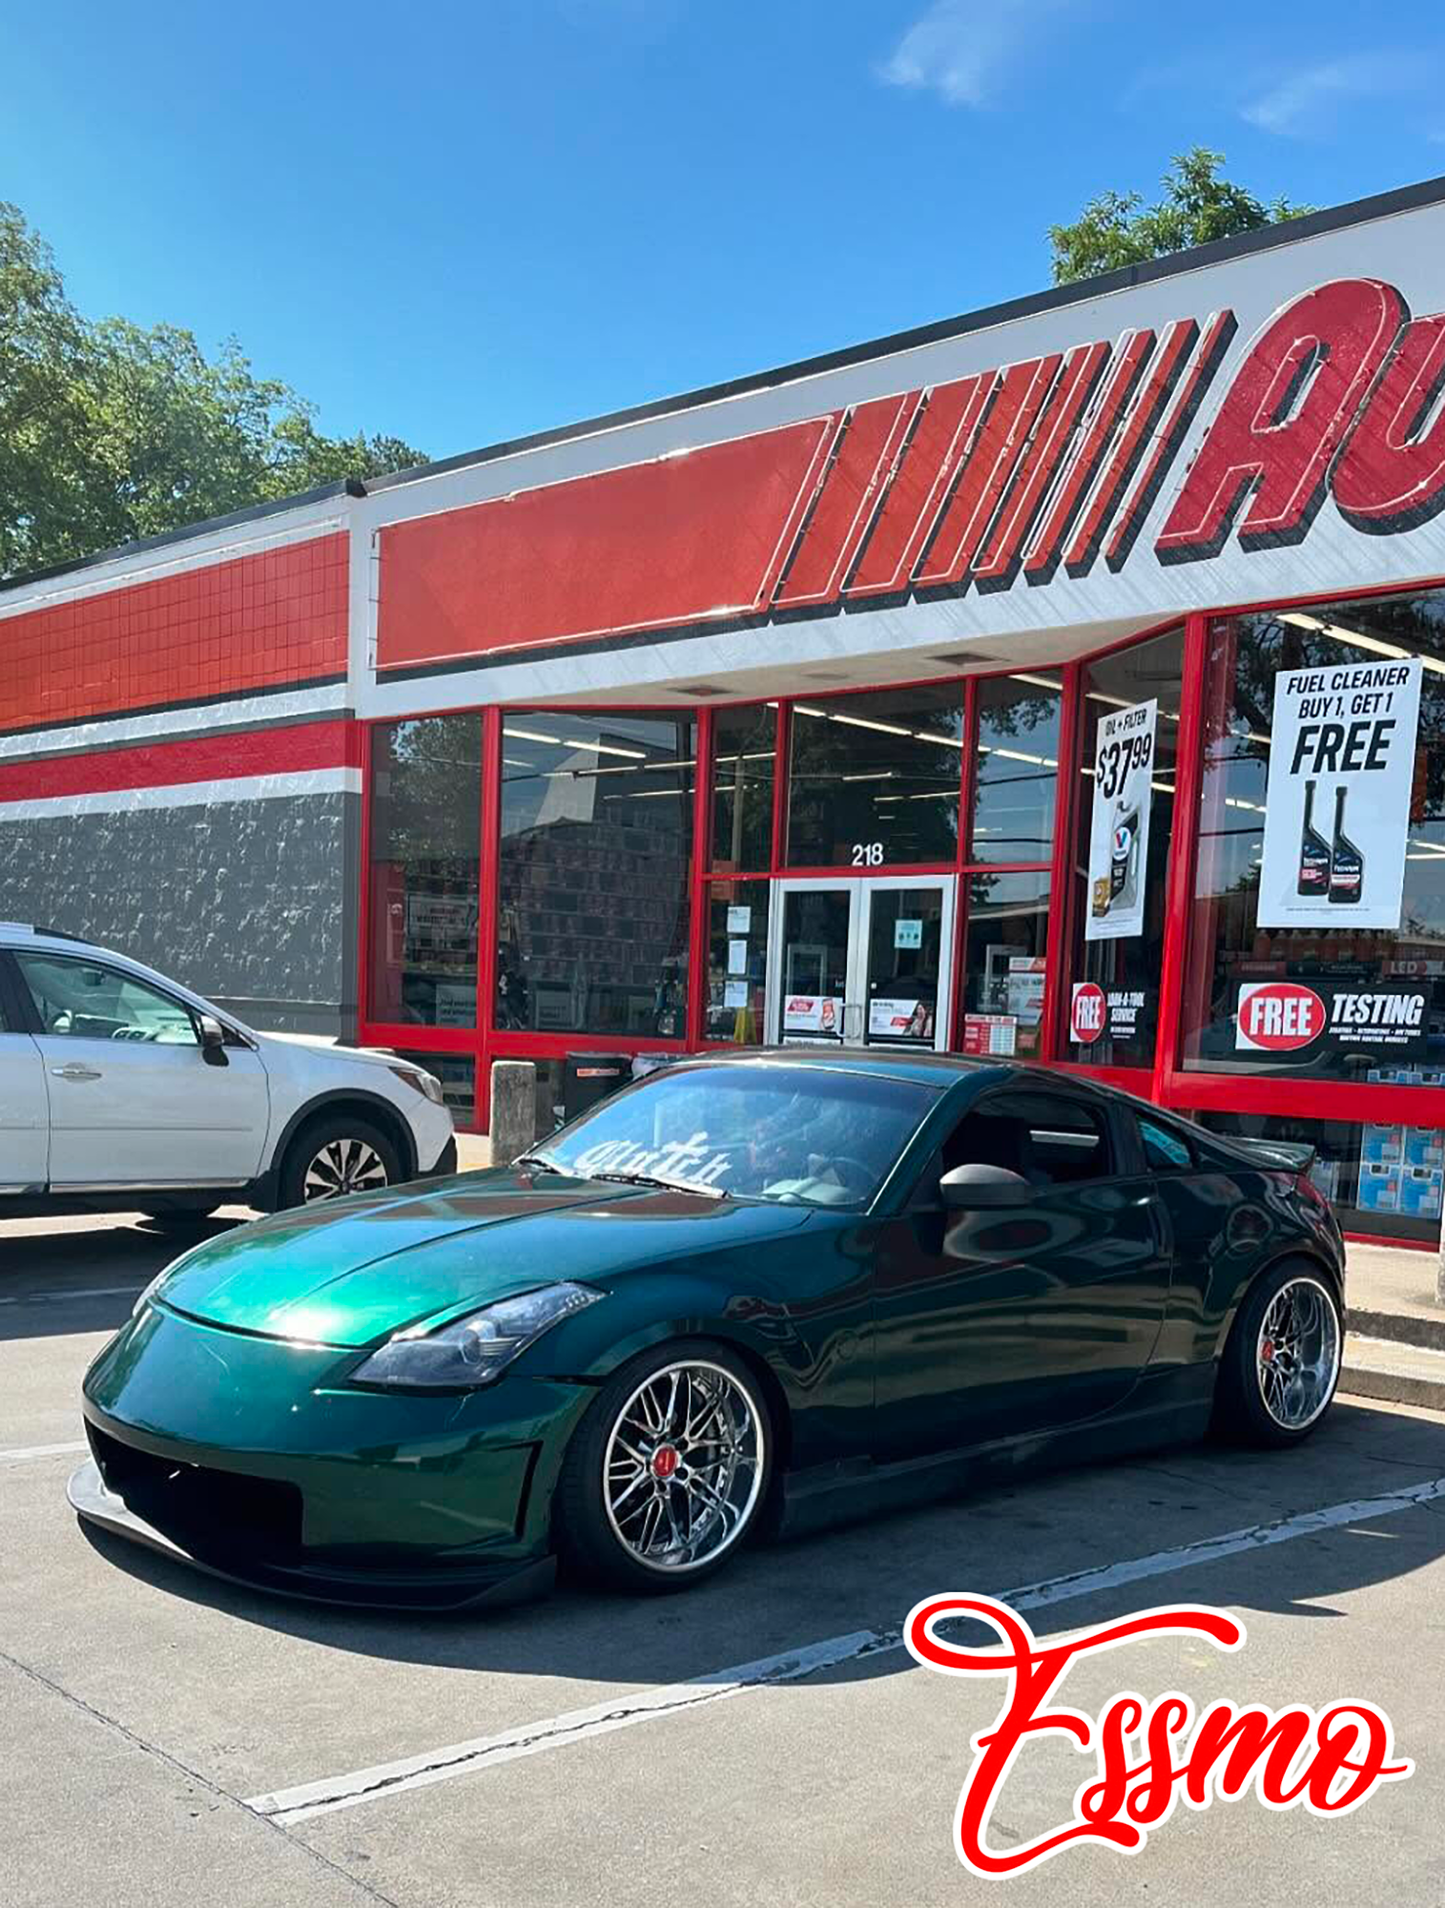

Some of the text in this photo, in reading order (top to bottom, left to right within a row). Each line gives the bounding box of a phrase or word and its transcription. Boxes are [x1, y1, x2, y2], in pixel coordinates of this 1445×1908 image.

[1286, 666, 1411, 695] FUEL CLEANER
[1298, 691, 1394, 719] BUY 1, GET 1
[1106, 719, 1115, 735] OIL
[1123, 708, 1147, 731] FILTER
[1290, 719, 1396, 775] FREE
[852, 842, 883, 866] 218
[1075, 995, 1101, 1029] FREE
[1111, 1008, 1138, 1023] SERVICE
[1249, 994, 1425, 1037] FREE TESTING
